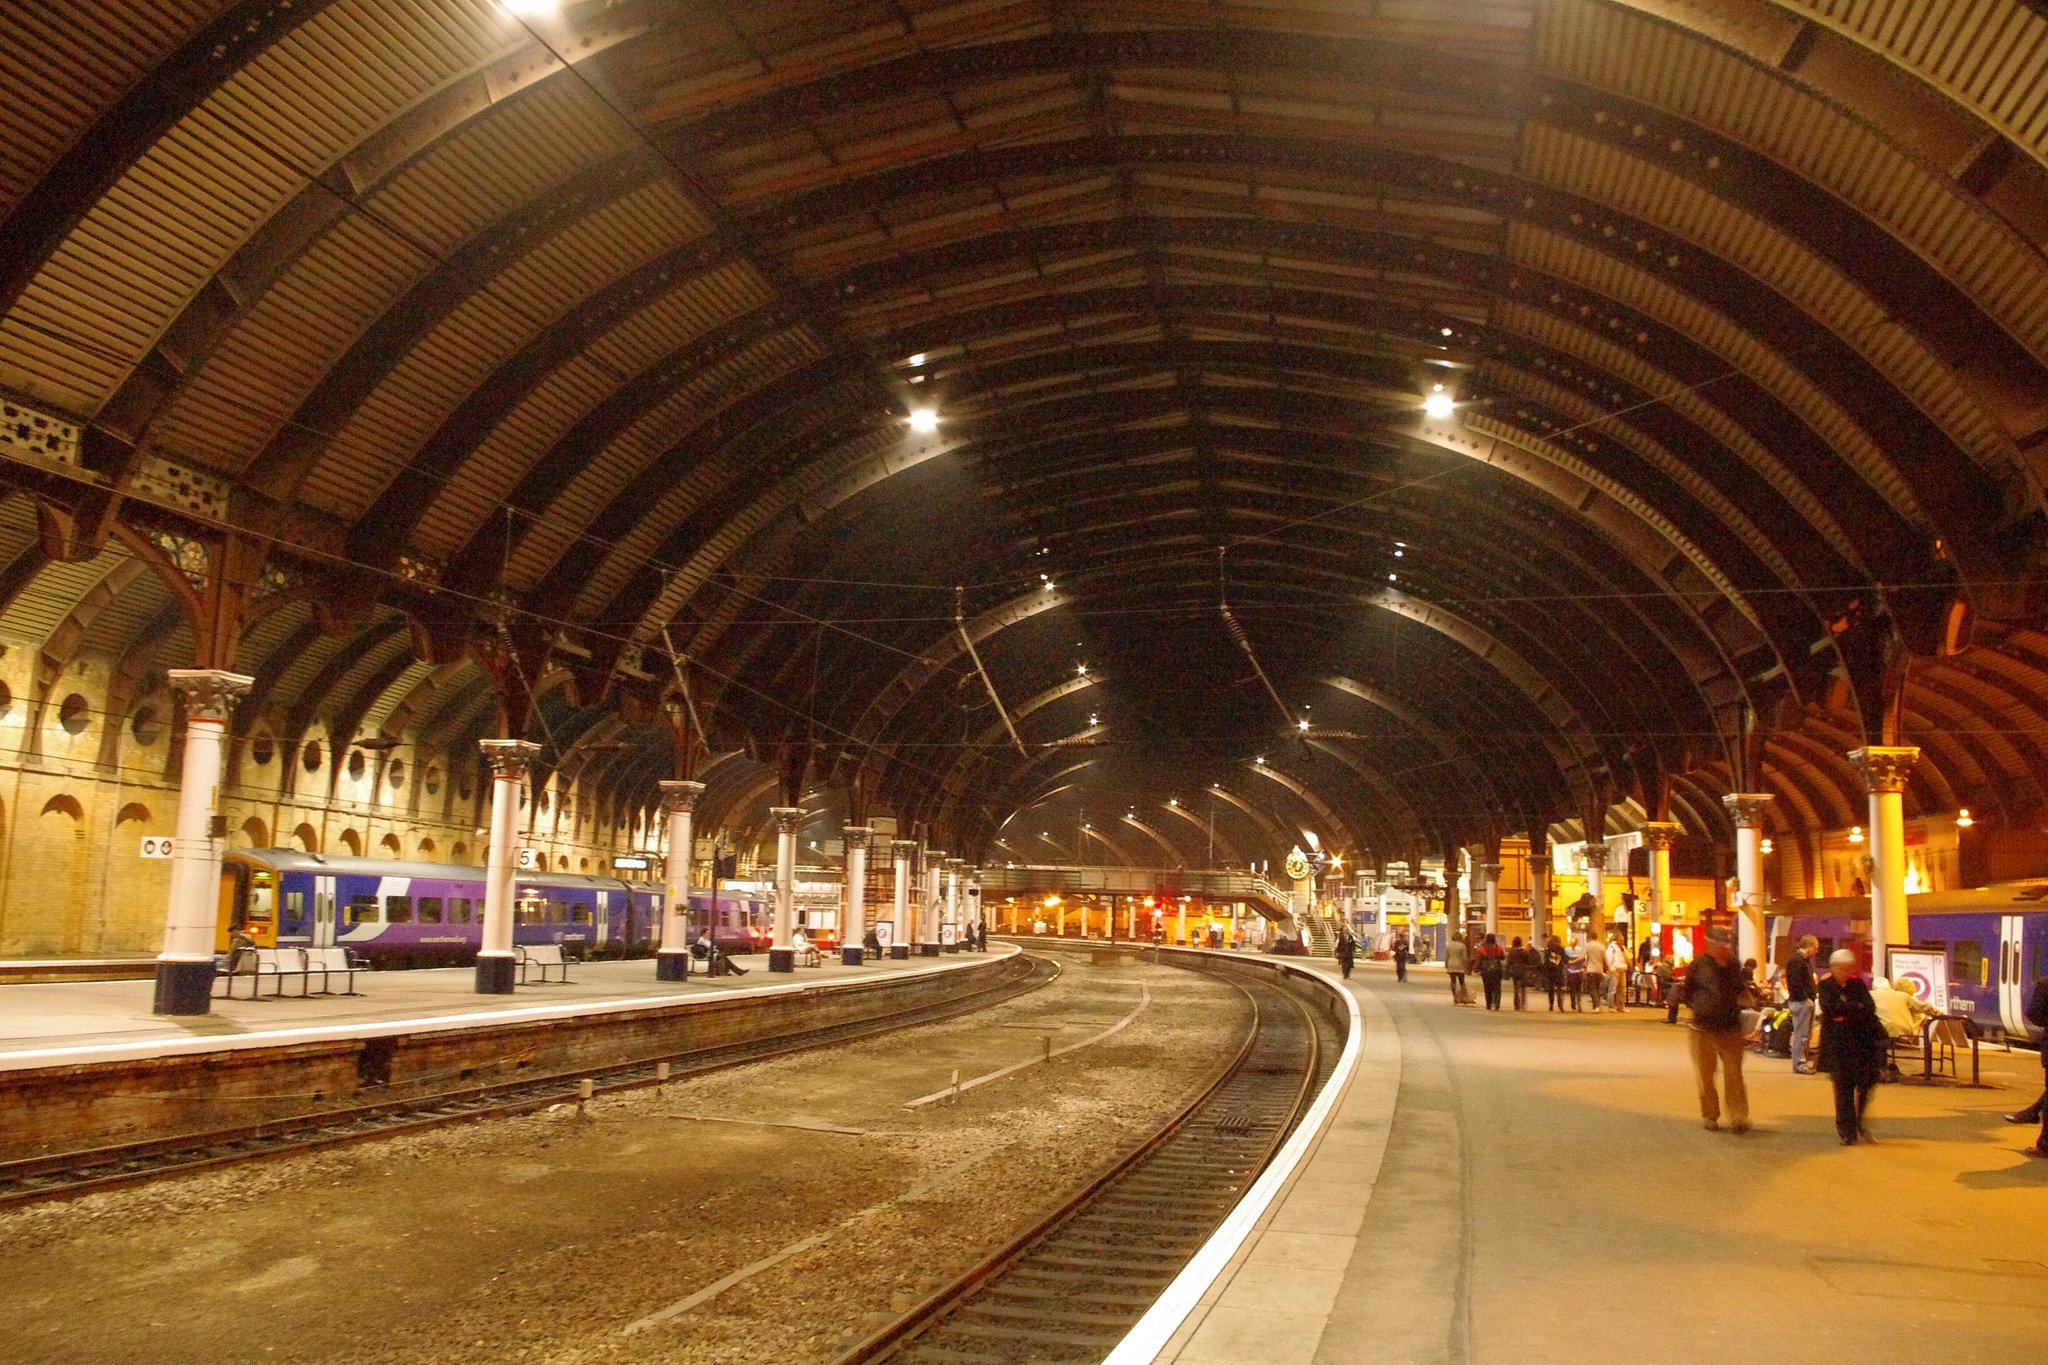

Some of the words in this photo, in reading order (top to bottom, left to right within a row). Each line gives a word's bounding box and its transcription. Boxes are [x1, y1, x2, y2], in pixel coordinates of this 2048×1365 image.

[520, 851, 530, 865] 5
[1638, 902, 1647, 913] 3
[1676, 903, 1681, 913] 1
[1950, 995, 1975, 1012] rthern
